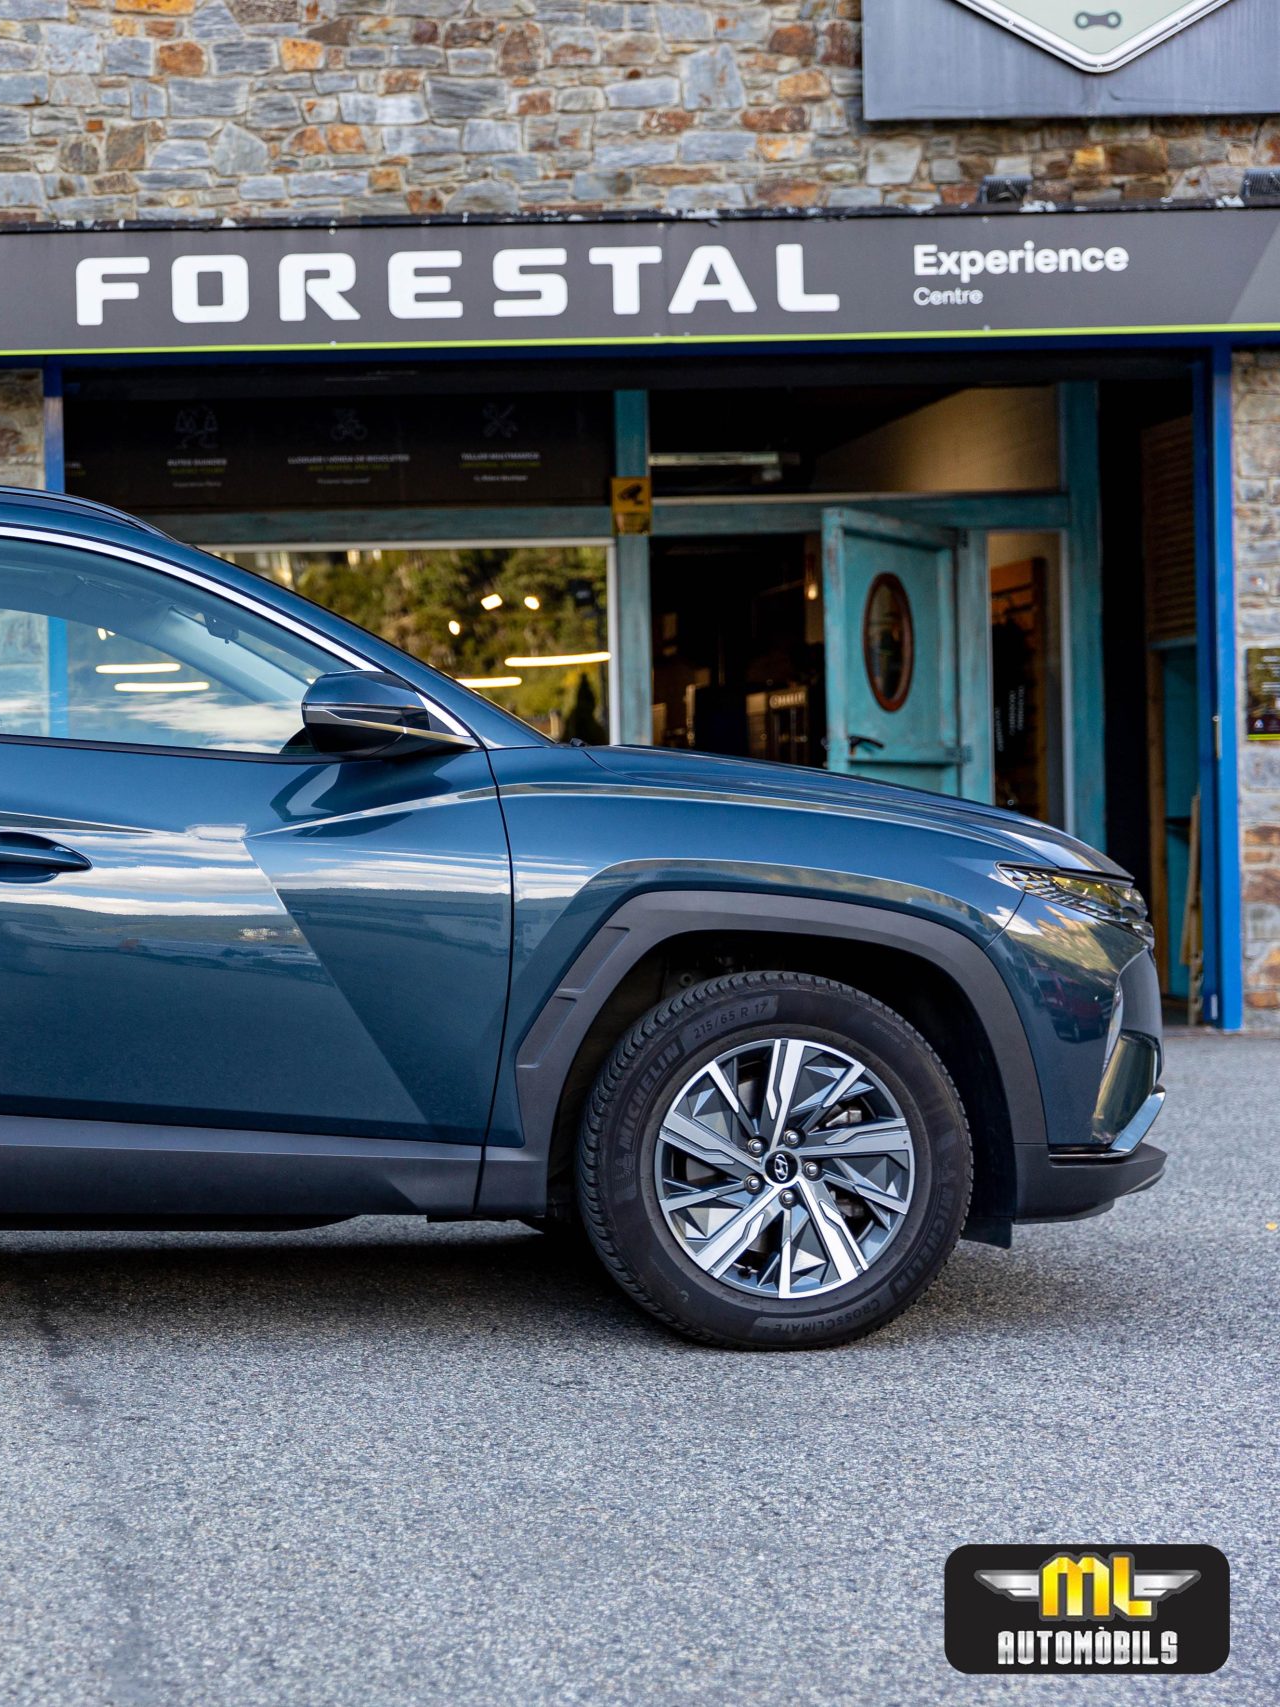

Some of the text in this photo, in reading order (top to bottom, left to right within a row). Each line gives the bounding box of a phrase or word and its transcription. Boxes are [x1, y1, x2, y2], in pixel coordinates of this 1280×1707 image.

[75, 243, 840, 326] FORESTAL
[913, 240, 1129, 283] Experience
[913, 287, 984, 306] Centre
[620, 1004, 768, 1150] MICHELIN 215/65 R 17
